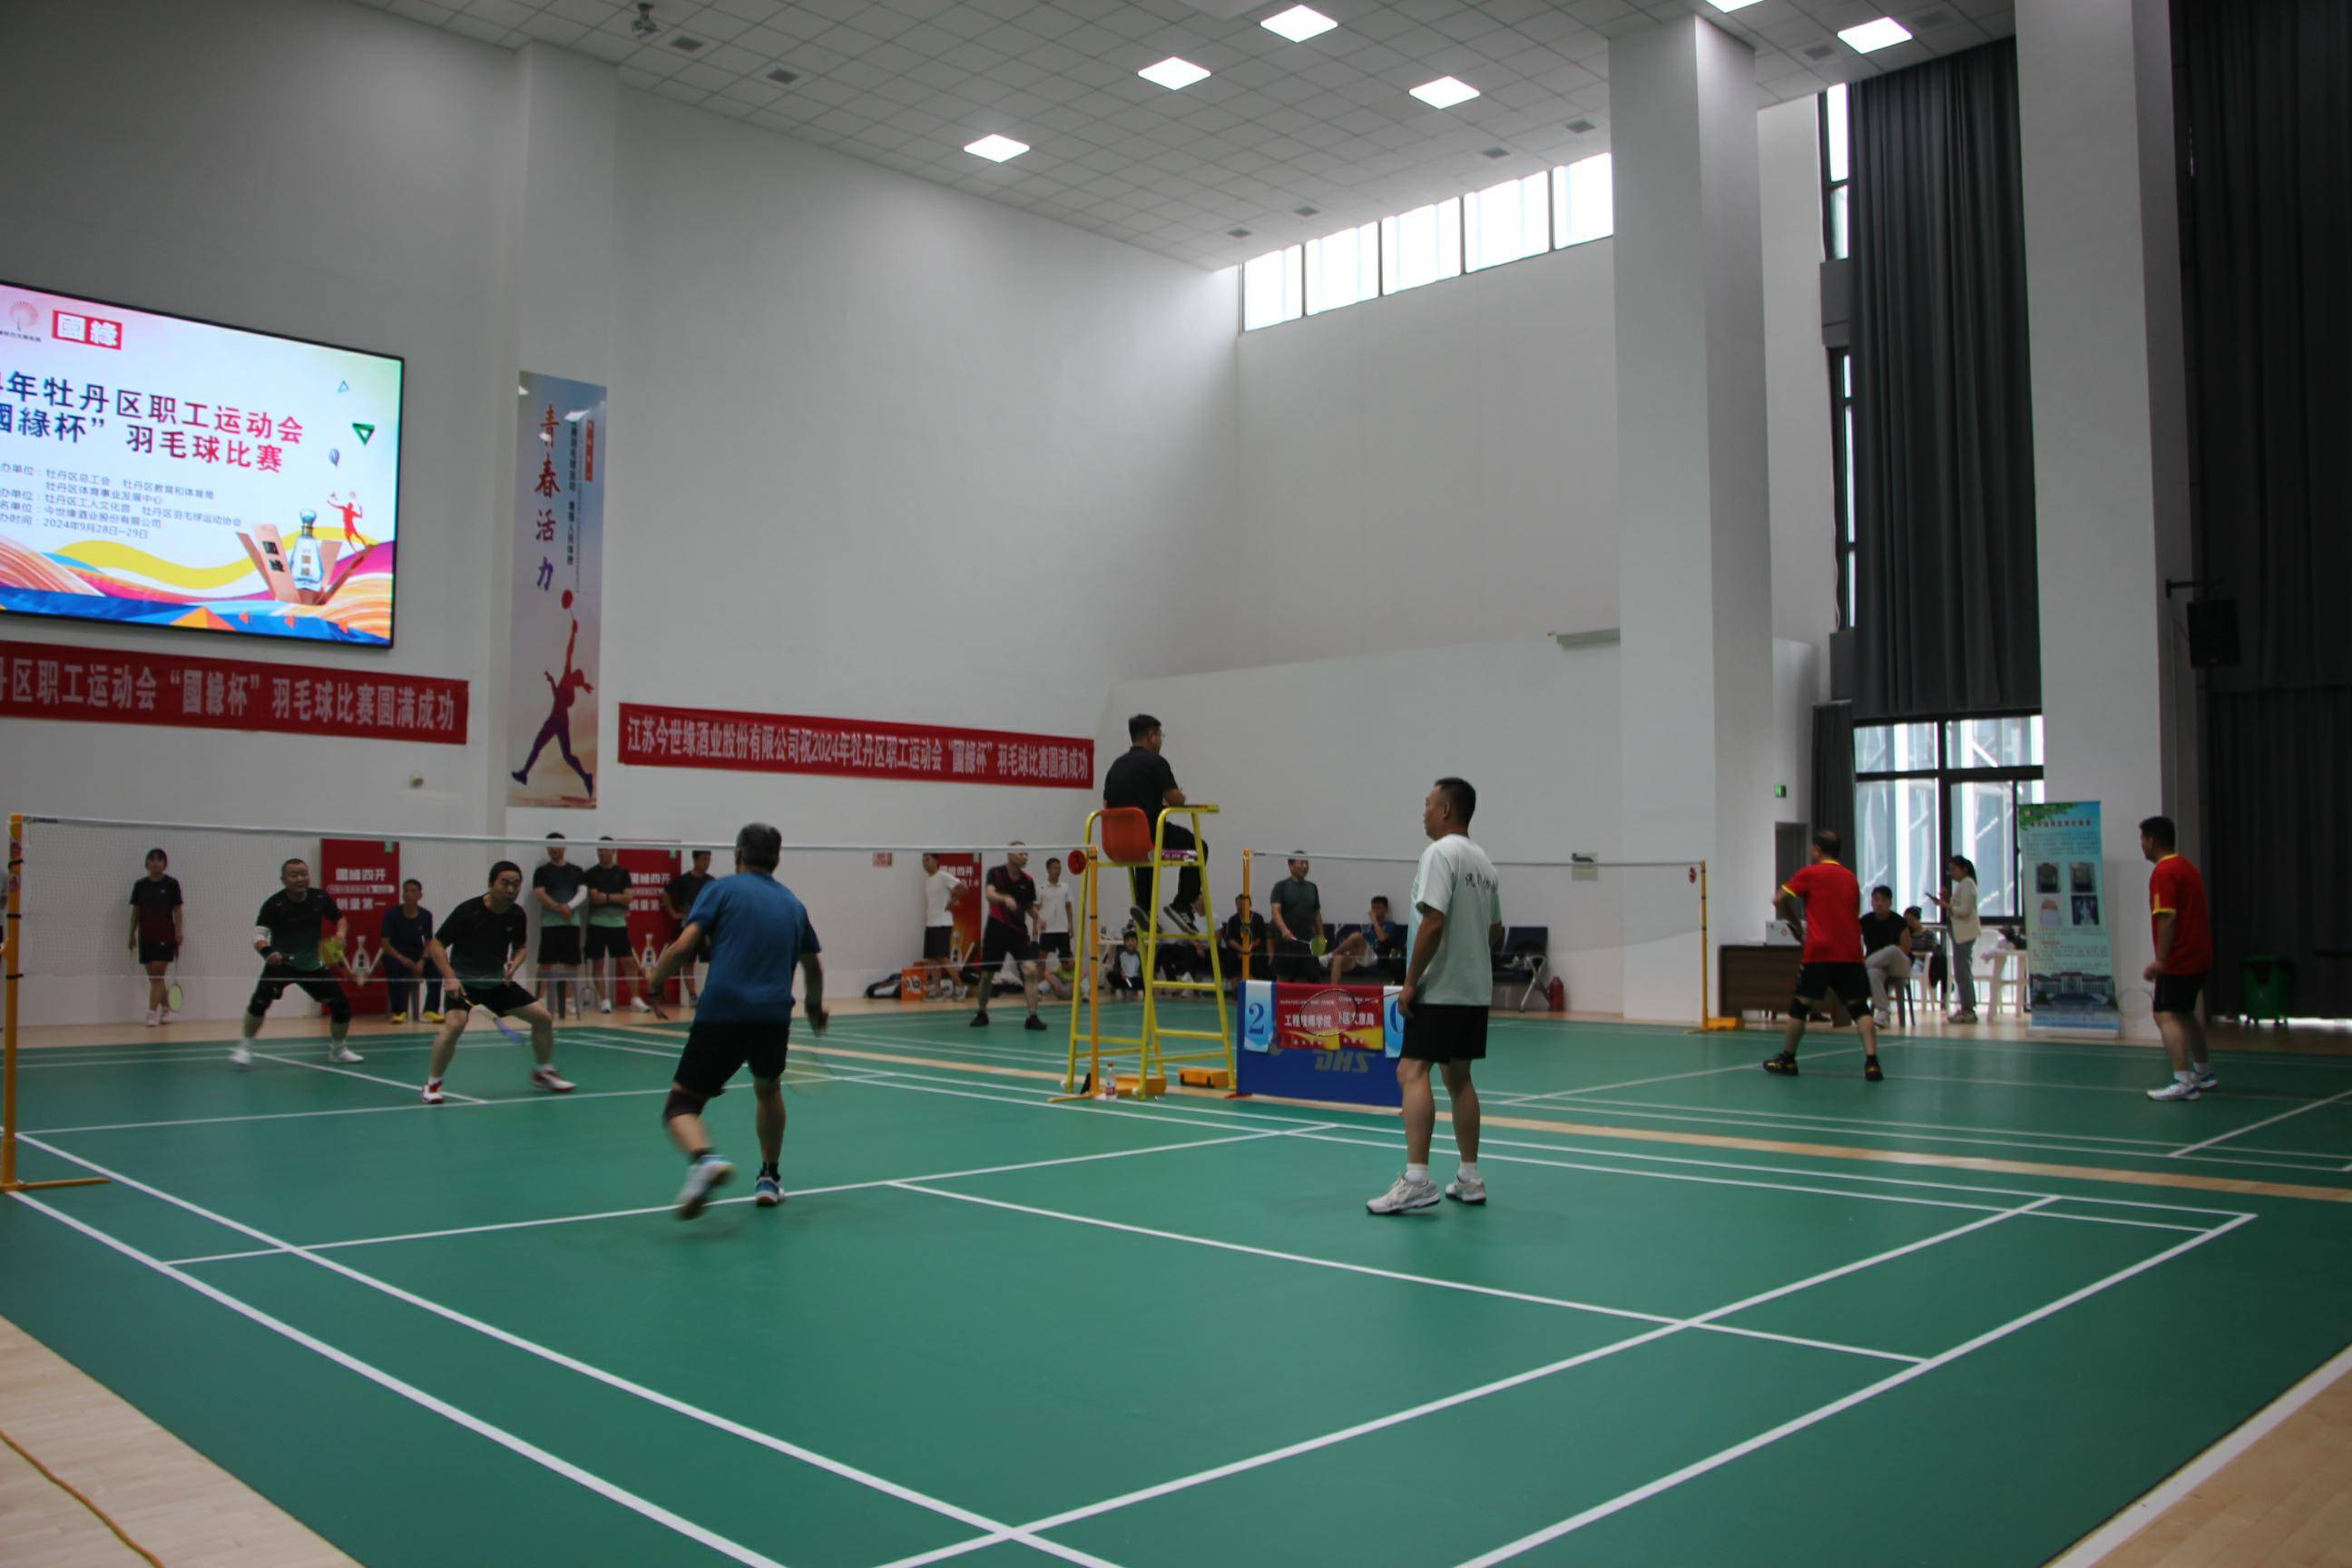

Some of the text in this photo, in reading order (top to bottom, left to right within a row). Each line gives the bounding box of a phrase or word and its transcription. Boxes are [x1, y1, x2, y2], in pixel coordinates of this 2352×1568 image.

[0, 370, 303, 444] 年牡丹区职工运动会
[1248, 1002, 1266, 1035] 2
